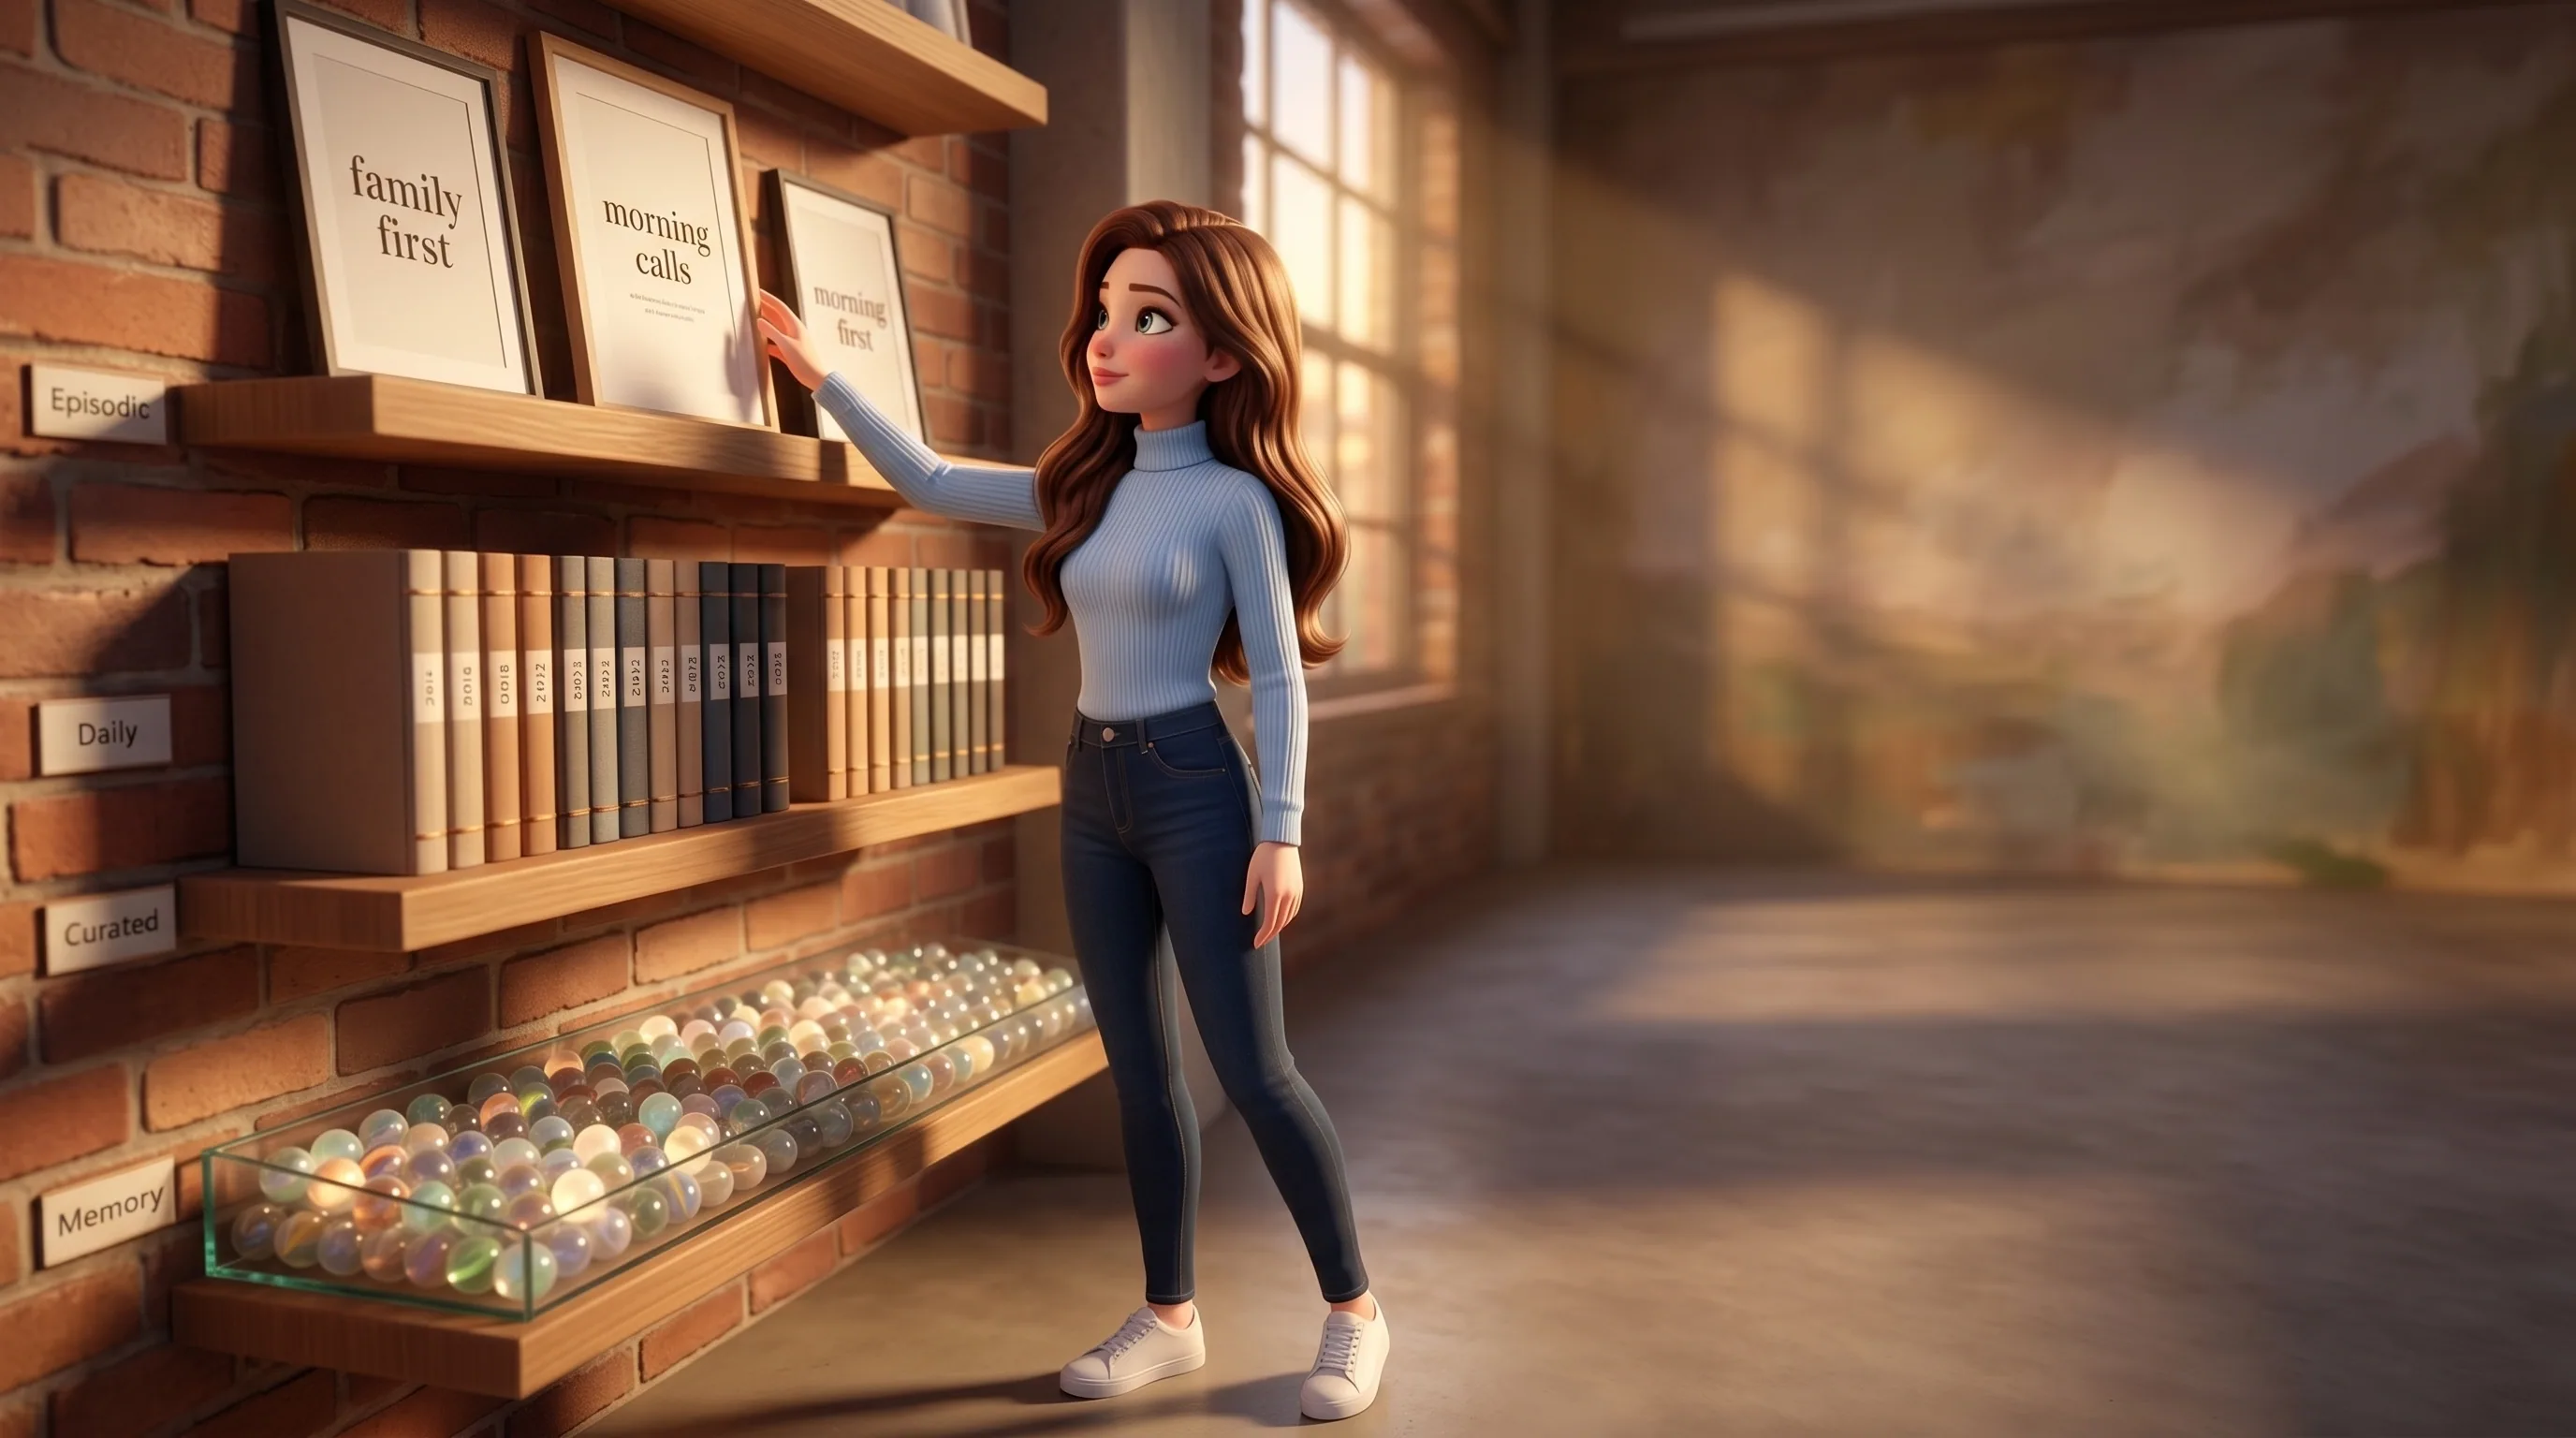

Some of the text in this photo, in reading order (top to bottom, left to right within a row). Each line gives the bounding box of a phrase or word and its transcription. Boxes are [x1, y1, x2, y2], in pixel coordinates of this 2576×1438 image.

[349, 154, 462, 230] family
[377, 213, 454, 269] first
[602, 198, 710, 257] morning
[636, 248, 692, 285] calls
[813, 285, 887, 329] morning
[837, 317, 874, 352] first
[51, 387, 151, 419] Episodic
[78, 720, 138, 749] Daily
[64, 908, 159, 947] Curated
[58, 1186, 165, 1238] Memory
